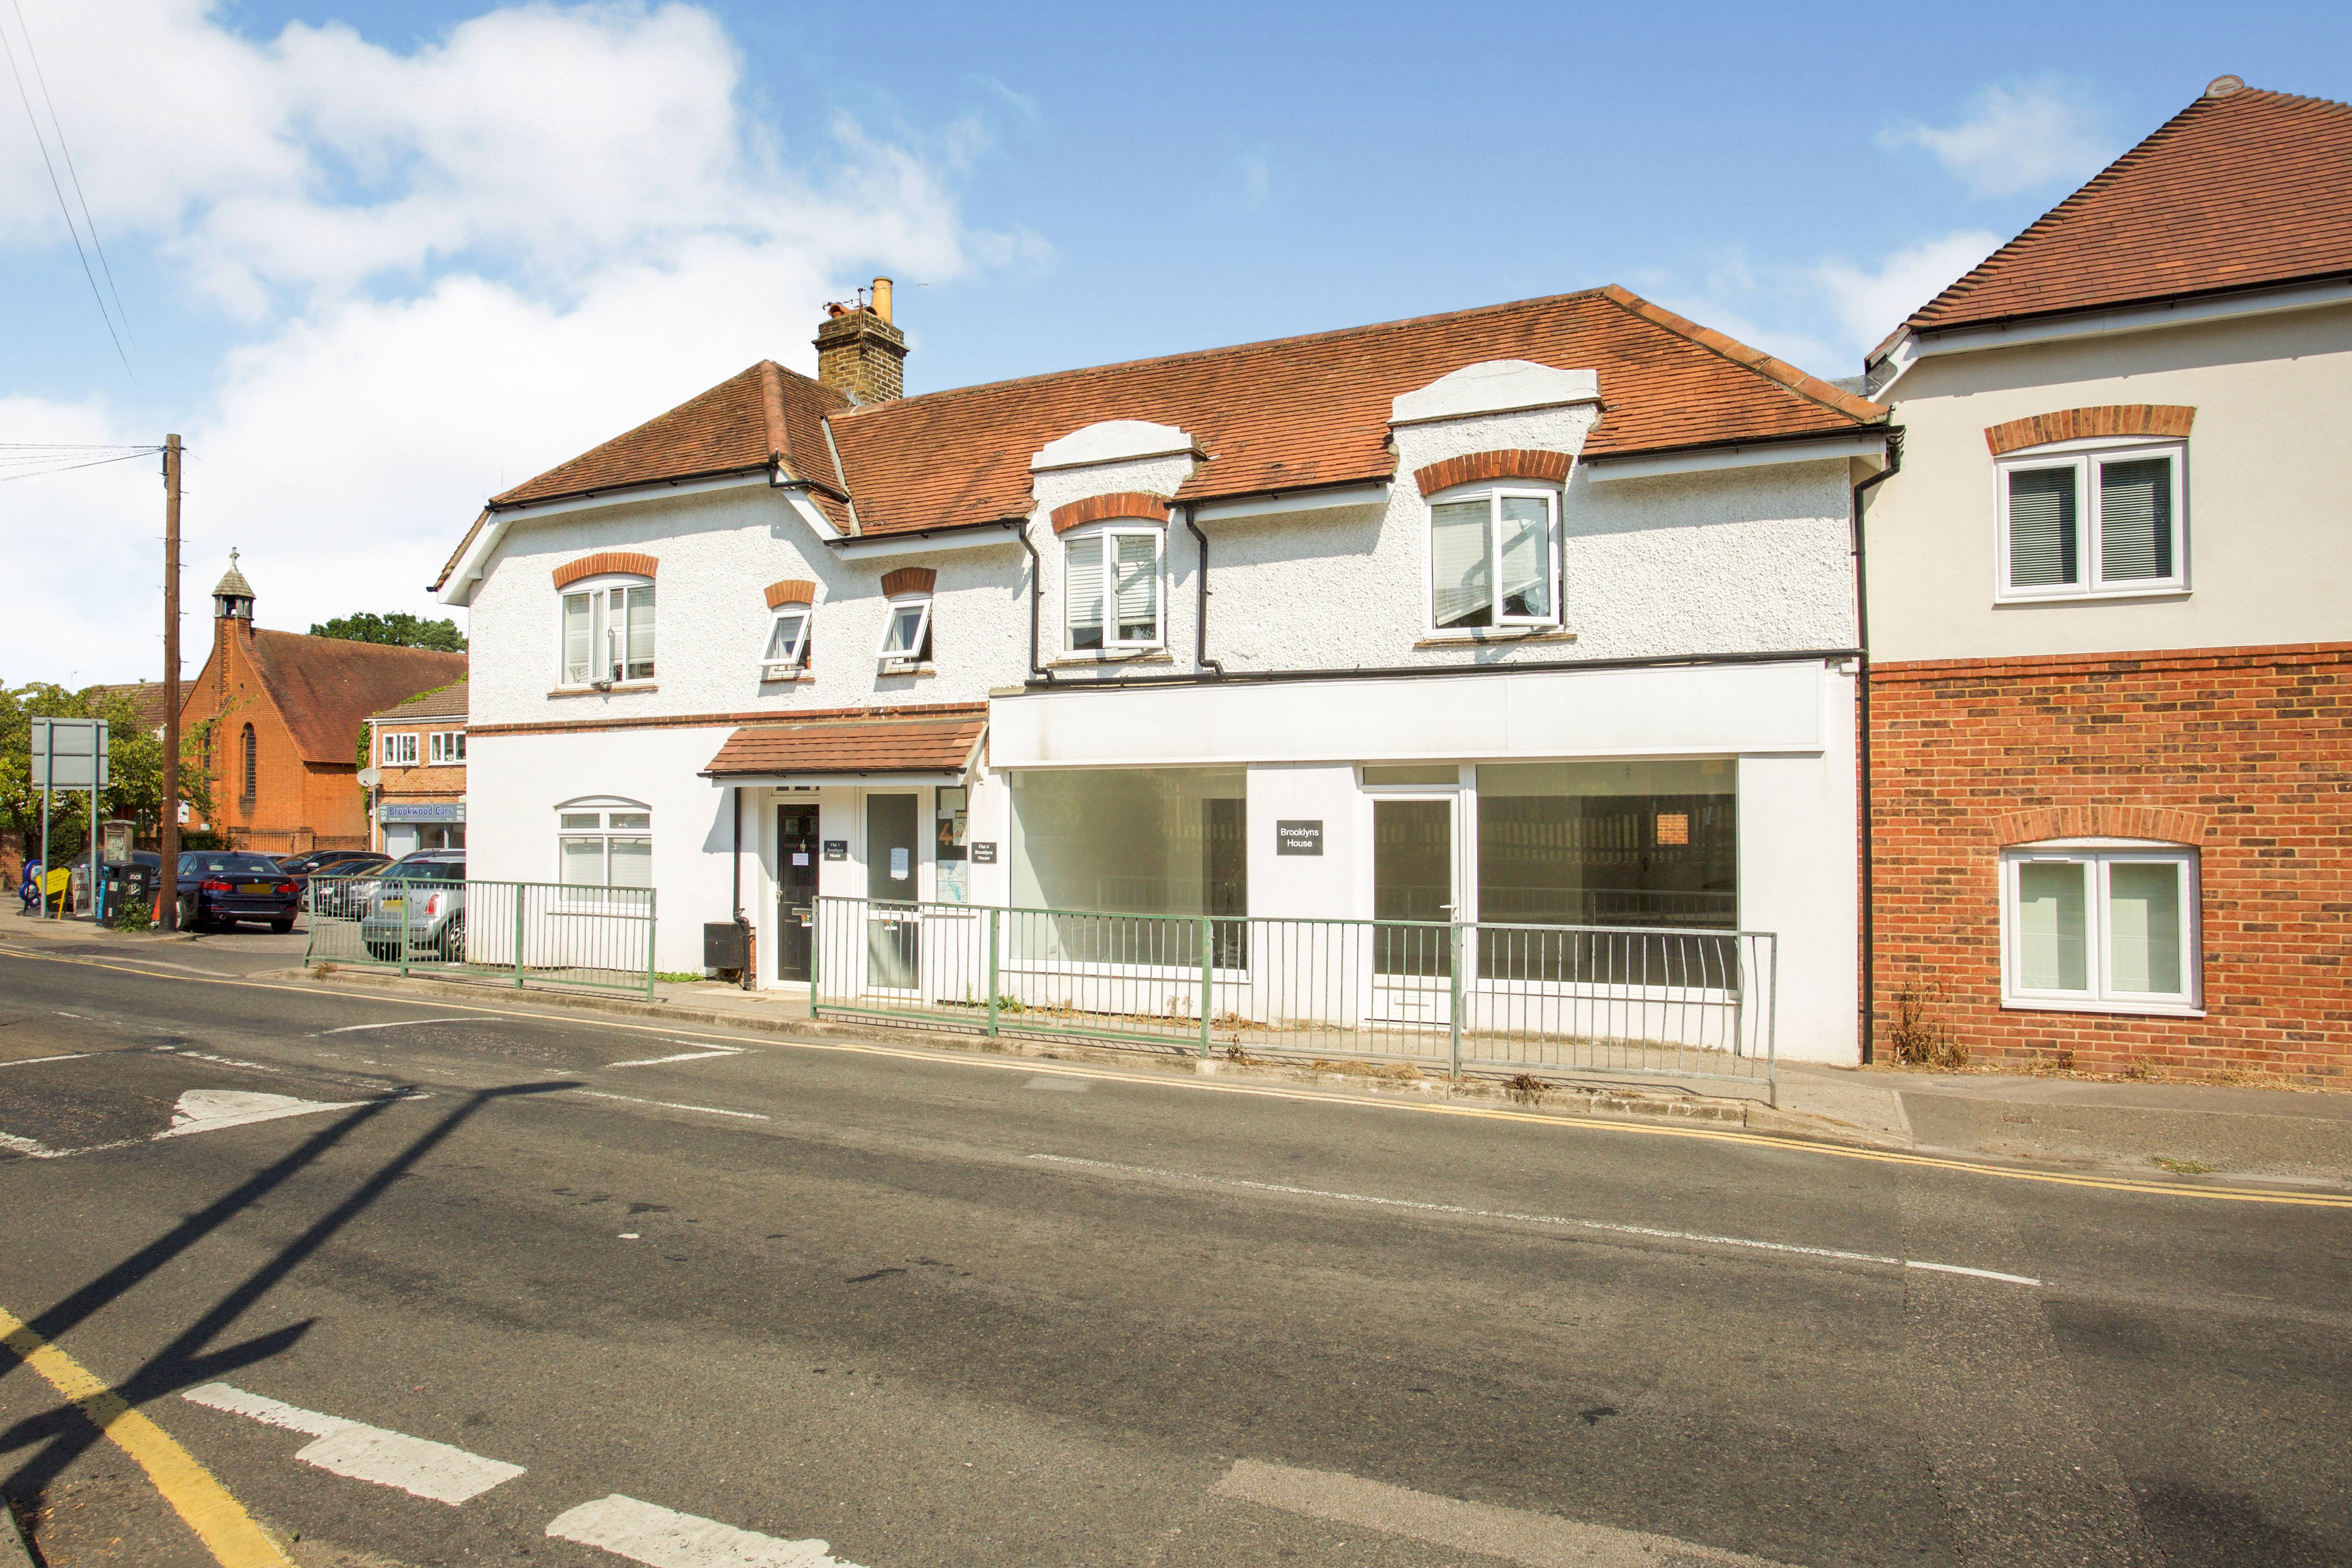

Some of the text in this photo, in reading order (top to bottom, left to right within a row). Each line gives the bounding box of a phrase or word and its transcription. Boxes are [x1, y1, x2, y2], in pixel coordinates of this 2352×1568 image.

[390, 805, 453, 816] Brookwood Cars
[938, 823, 954, 845] 4
[1281, 828, 1319, 838] Brooklyns
[77, 899, 89, 910] OPEN
